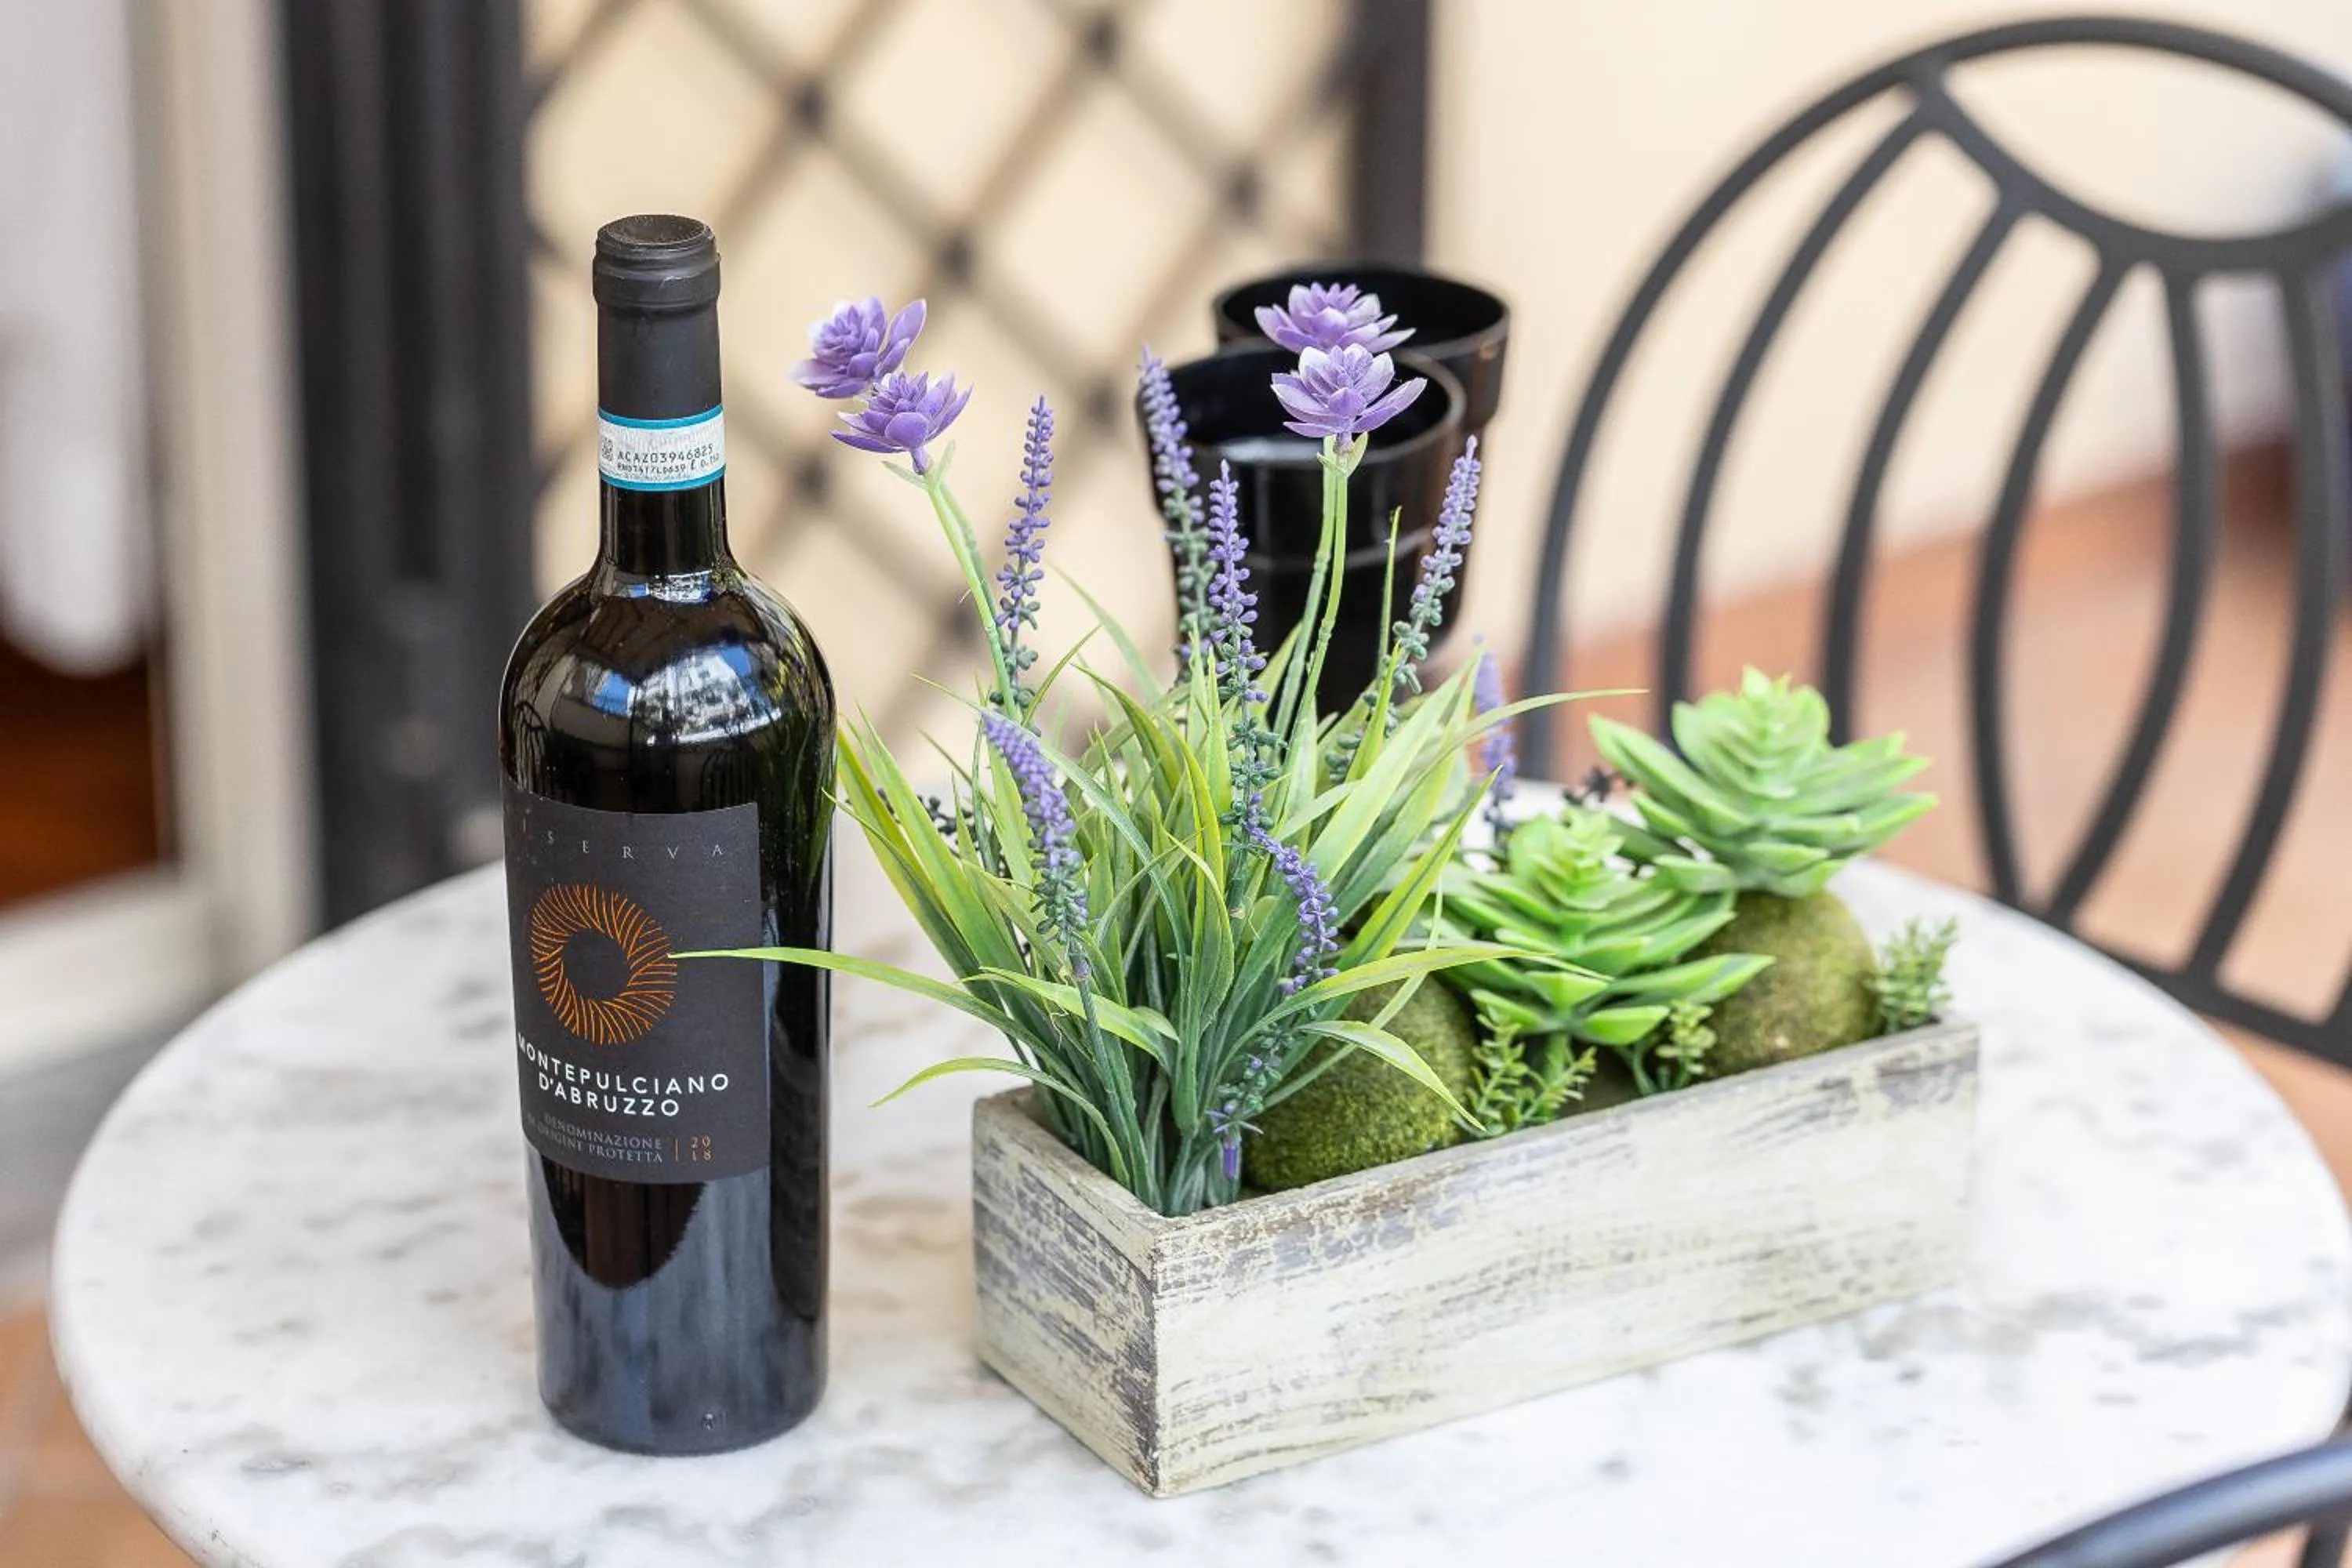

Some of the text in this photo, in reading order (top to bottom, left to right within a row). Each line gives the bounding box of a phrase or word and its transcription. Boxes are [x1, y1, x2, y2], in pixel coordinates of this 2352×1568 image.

[517, 1031, 729, 1095] MONTEPULCIANO
[539, 1072, 680, 1117] D'ABRUZZO
[545, 1113, 663, 1150] DENOMINAZIONE
[588, 1143, 663, 1164] PROTETTA
